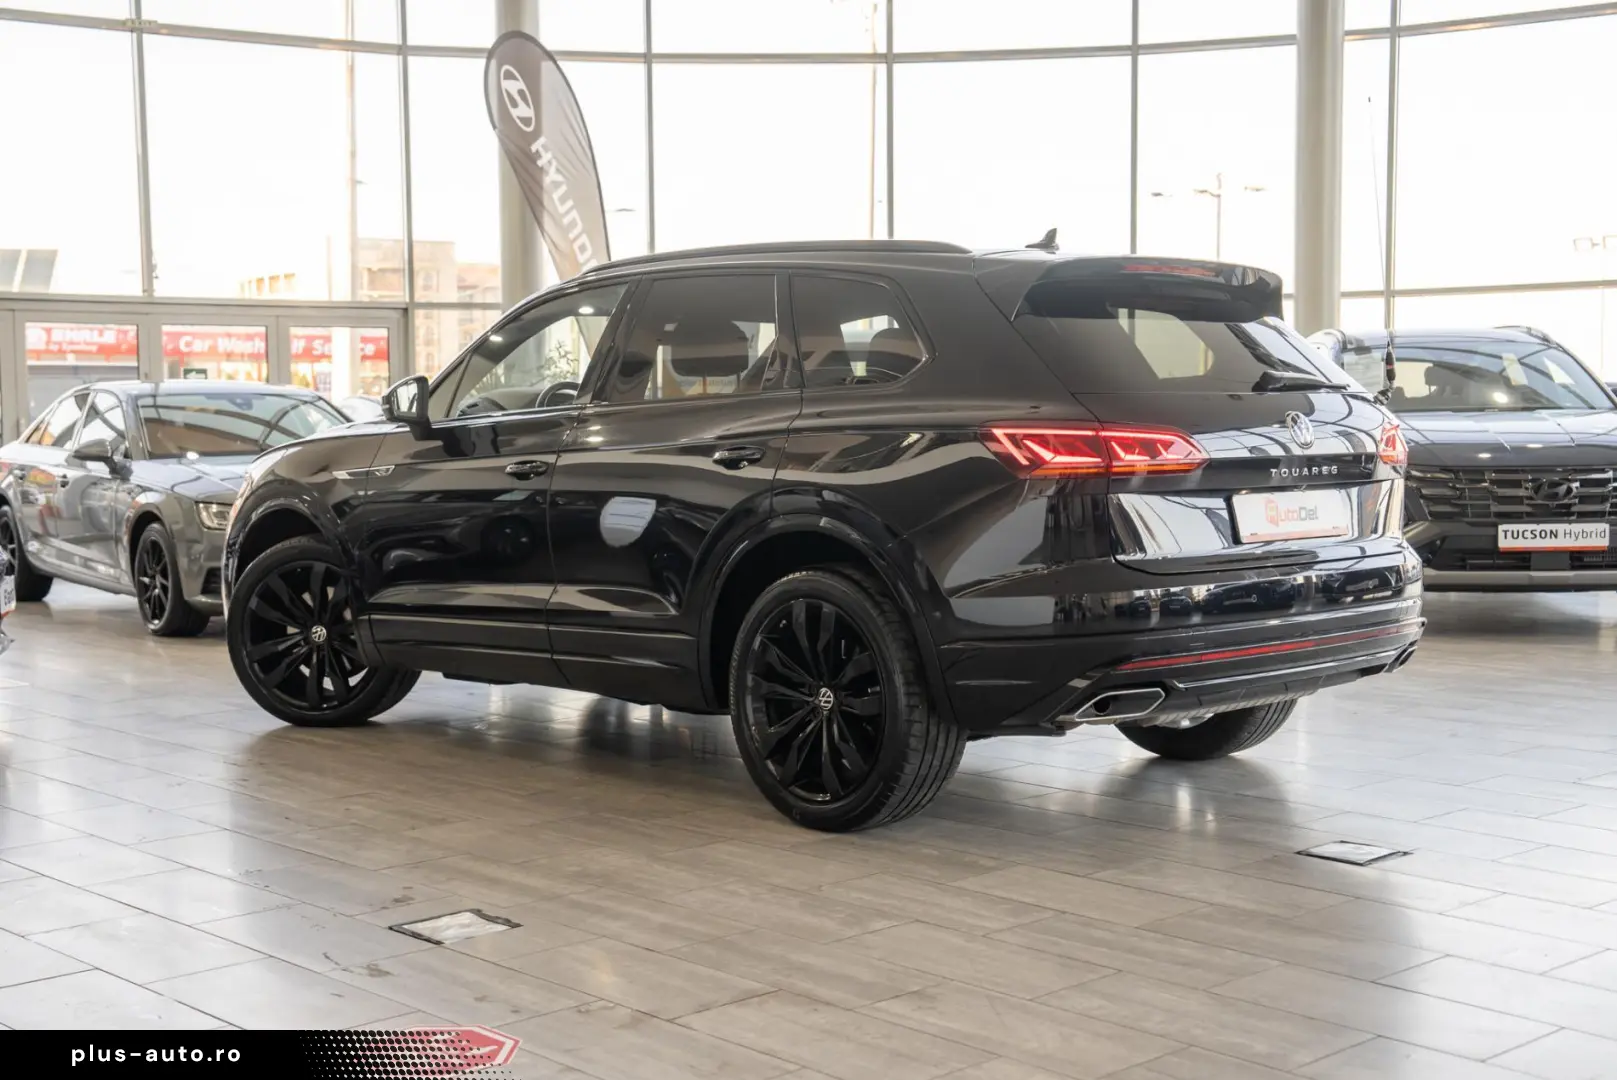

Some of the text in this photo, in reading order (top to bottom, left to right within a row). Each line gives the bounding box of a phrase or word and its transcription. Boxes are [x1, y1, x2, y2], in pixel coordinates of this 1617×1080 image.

[531, 136, 600, 274] HYUND
[179, 335, 212, 353] Car
[218, 336, 265, 354] Wash
[1270, 465, 1338, 478] TOUAREG
[1502, 528, 1606, 542] TUCSON Hybrid
